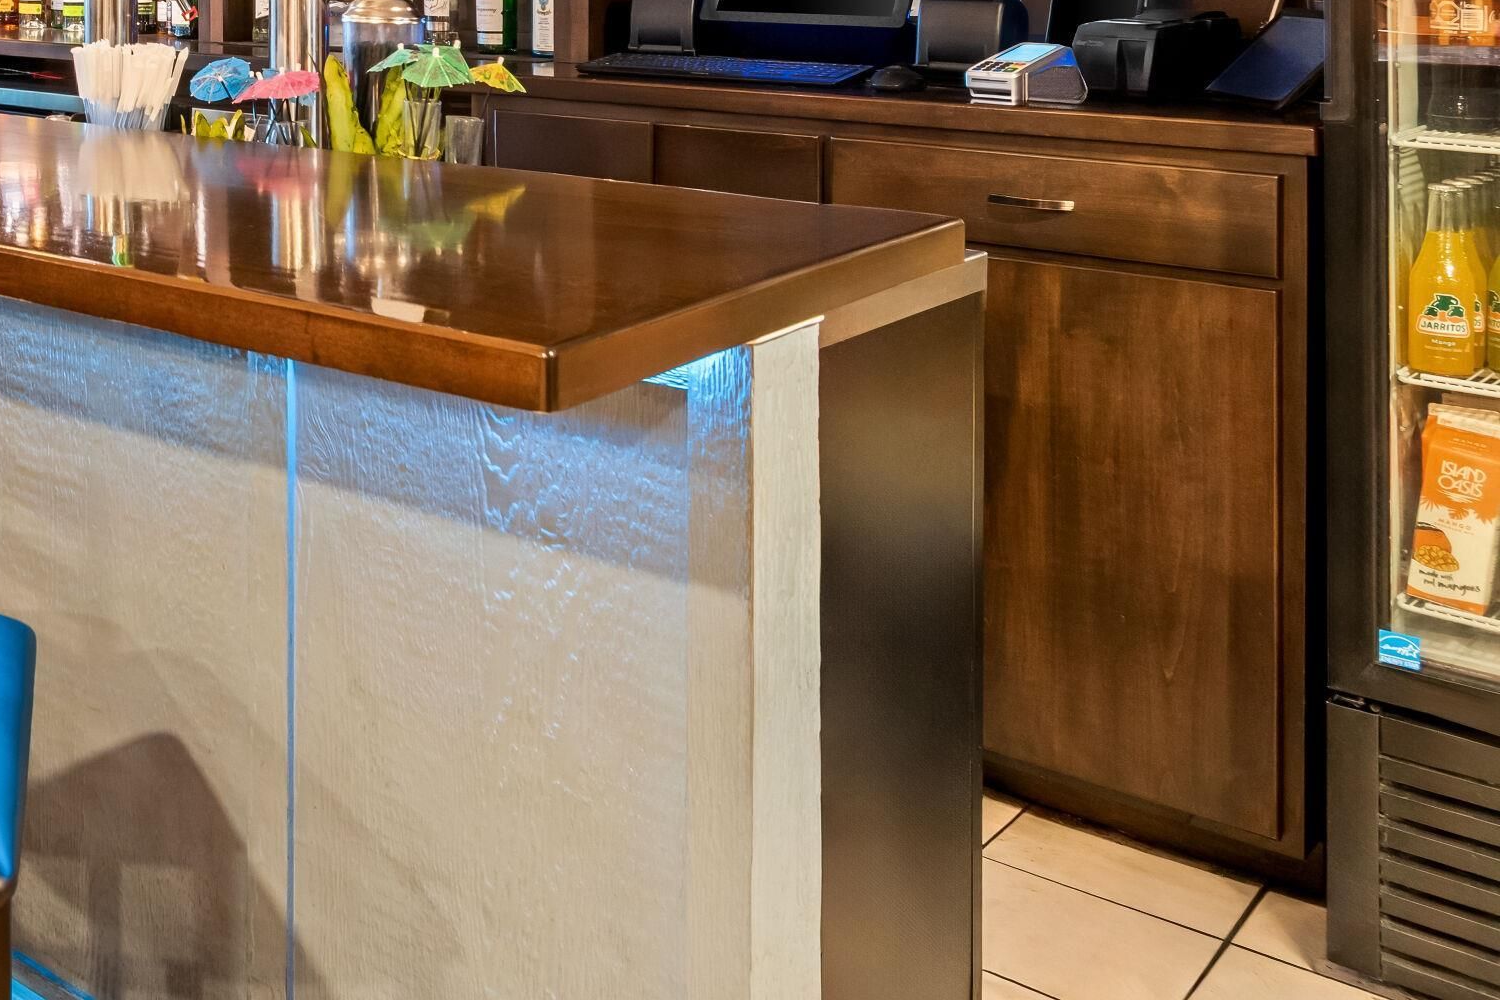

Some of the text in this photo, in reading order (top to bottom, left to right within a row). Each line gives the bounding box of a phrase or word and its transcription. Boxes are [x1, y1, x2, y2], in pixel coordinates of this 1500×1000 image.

[1420, 320, 1466, 333] JARRITOS
[1441, 460, 1487, 484] ISLAND
[1438, 475, 1483, 498] OASIS
[1438, 518, 1472, 531] MANGO
[1418, 569, 1439, 579] made
[1437, 581, 1481, 596] mangoes
